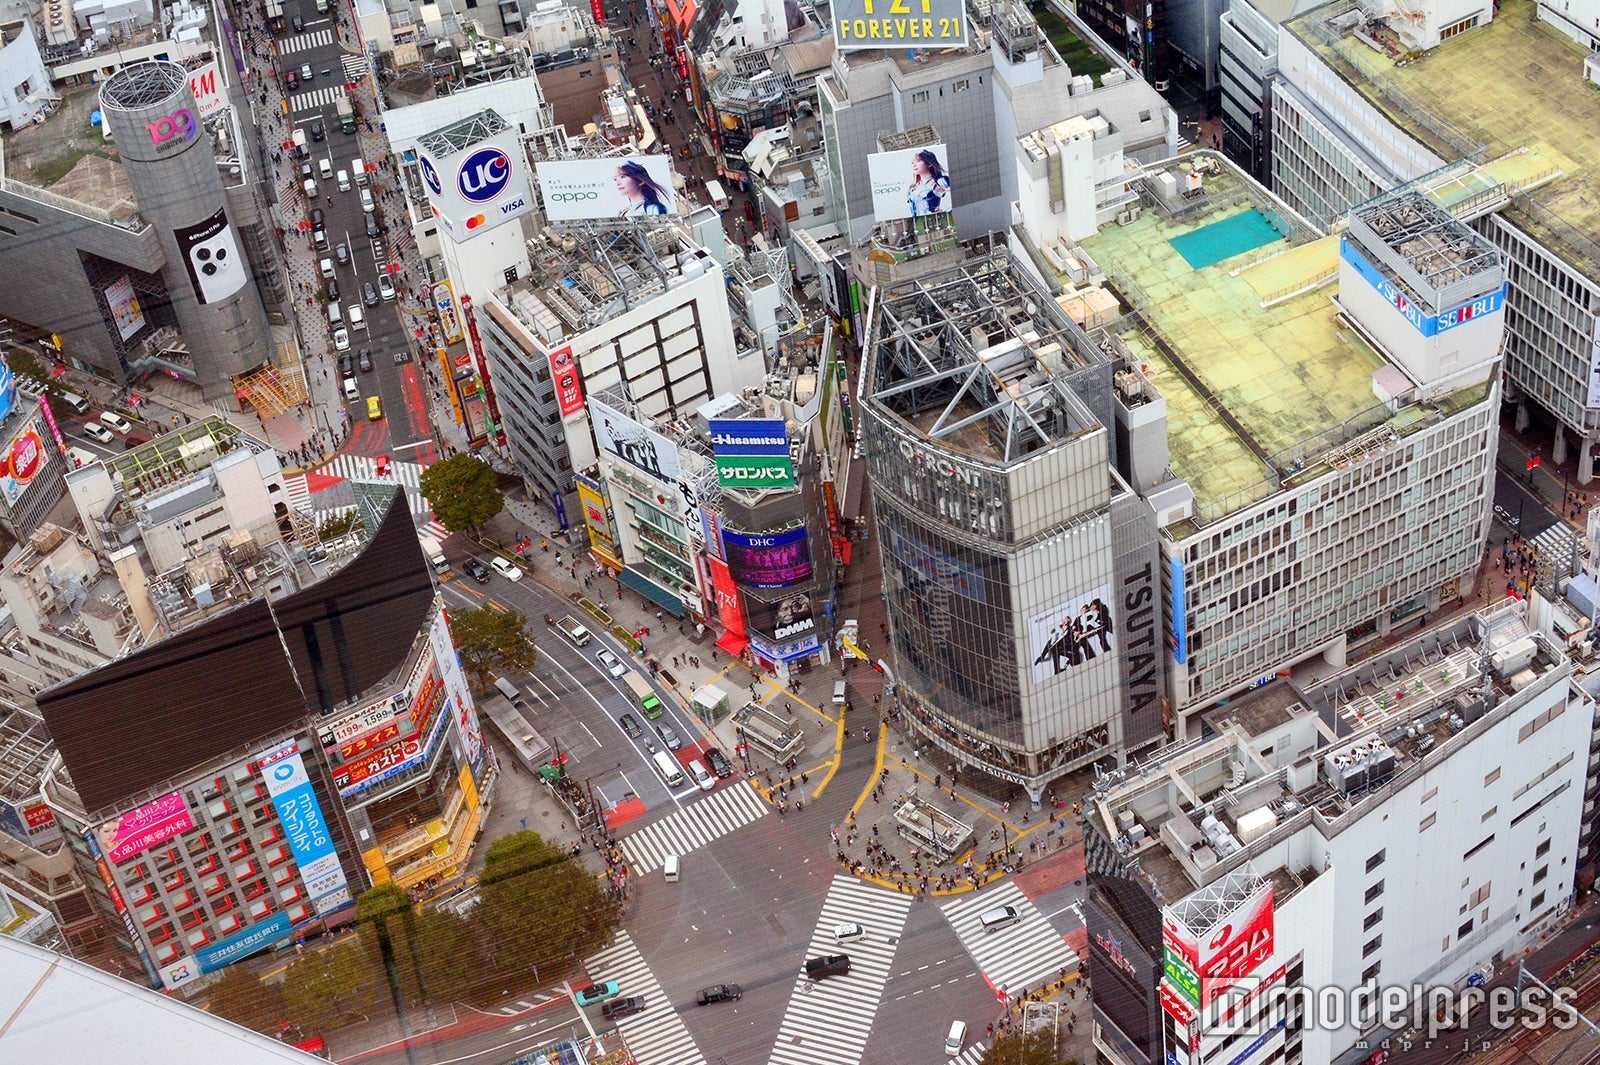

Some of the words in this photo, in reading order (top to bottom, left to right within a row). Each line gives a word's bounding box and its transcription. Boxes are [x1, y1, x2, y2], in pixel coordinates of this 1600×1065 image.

[841, 19, 934, 39] FOREVER
[939, 18, 960, 37] 21
[146, 109, 196, 144] 109
[501, 199, 525, 214] VISA
[552, 191, 598, 203] oppo
[1384, 282, 1421, 329] SEIBU
[1438, 296, 1495, 331] SEIBU
[711, 433, 785, 445] Hisamitsu
[720, 467, 789, 480] サロンパス
[749, 538, 775, 547] DHC
[774, 618, 814, 639] DMM
[1123, 561, 1157, 715] TSUTAYA
[321, 733, 333, 743] 9F
[368, 753, 401, 774] ガスト
[273, 774, 304, 792] eyecity
[336, 775, 350, 786] 7F
[981, 764, 1026, 785] TSUTAYA
[139, 806, 176, 826] クリニック
[280, 799, 312, 852] アイシティ
[298, 793, 326, 847] コンタクトの
[121, 818, 188, 855] 品川美容外科
[209, 923, 280, 961] 三井住友信託銀行
[1166, 950, 1198, 986] レイク
[1207, 928, 1271, 988] アコム
[1166, 964, 1200, 1000] ALSA
